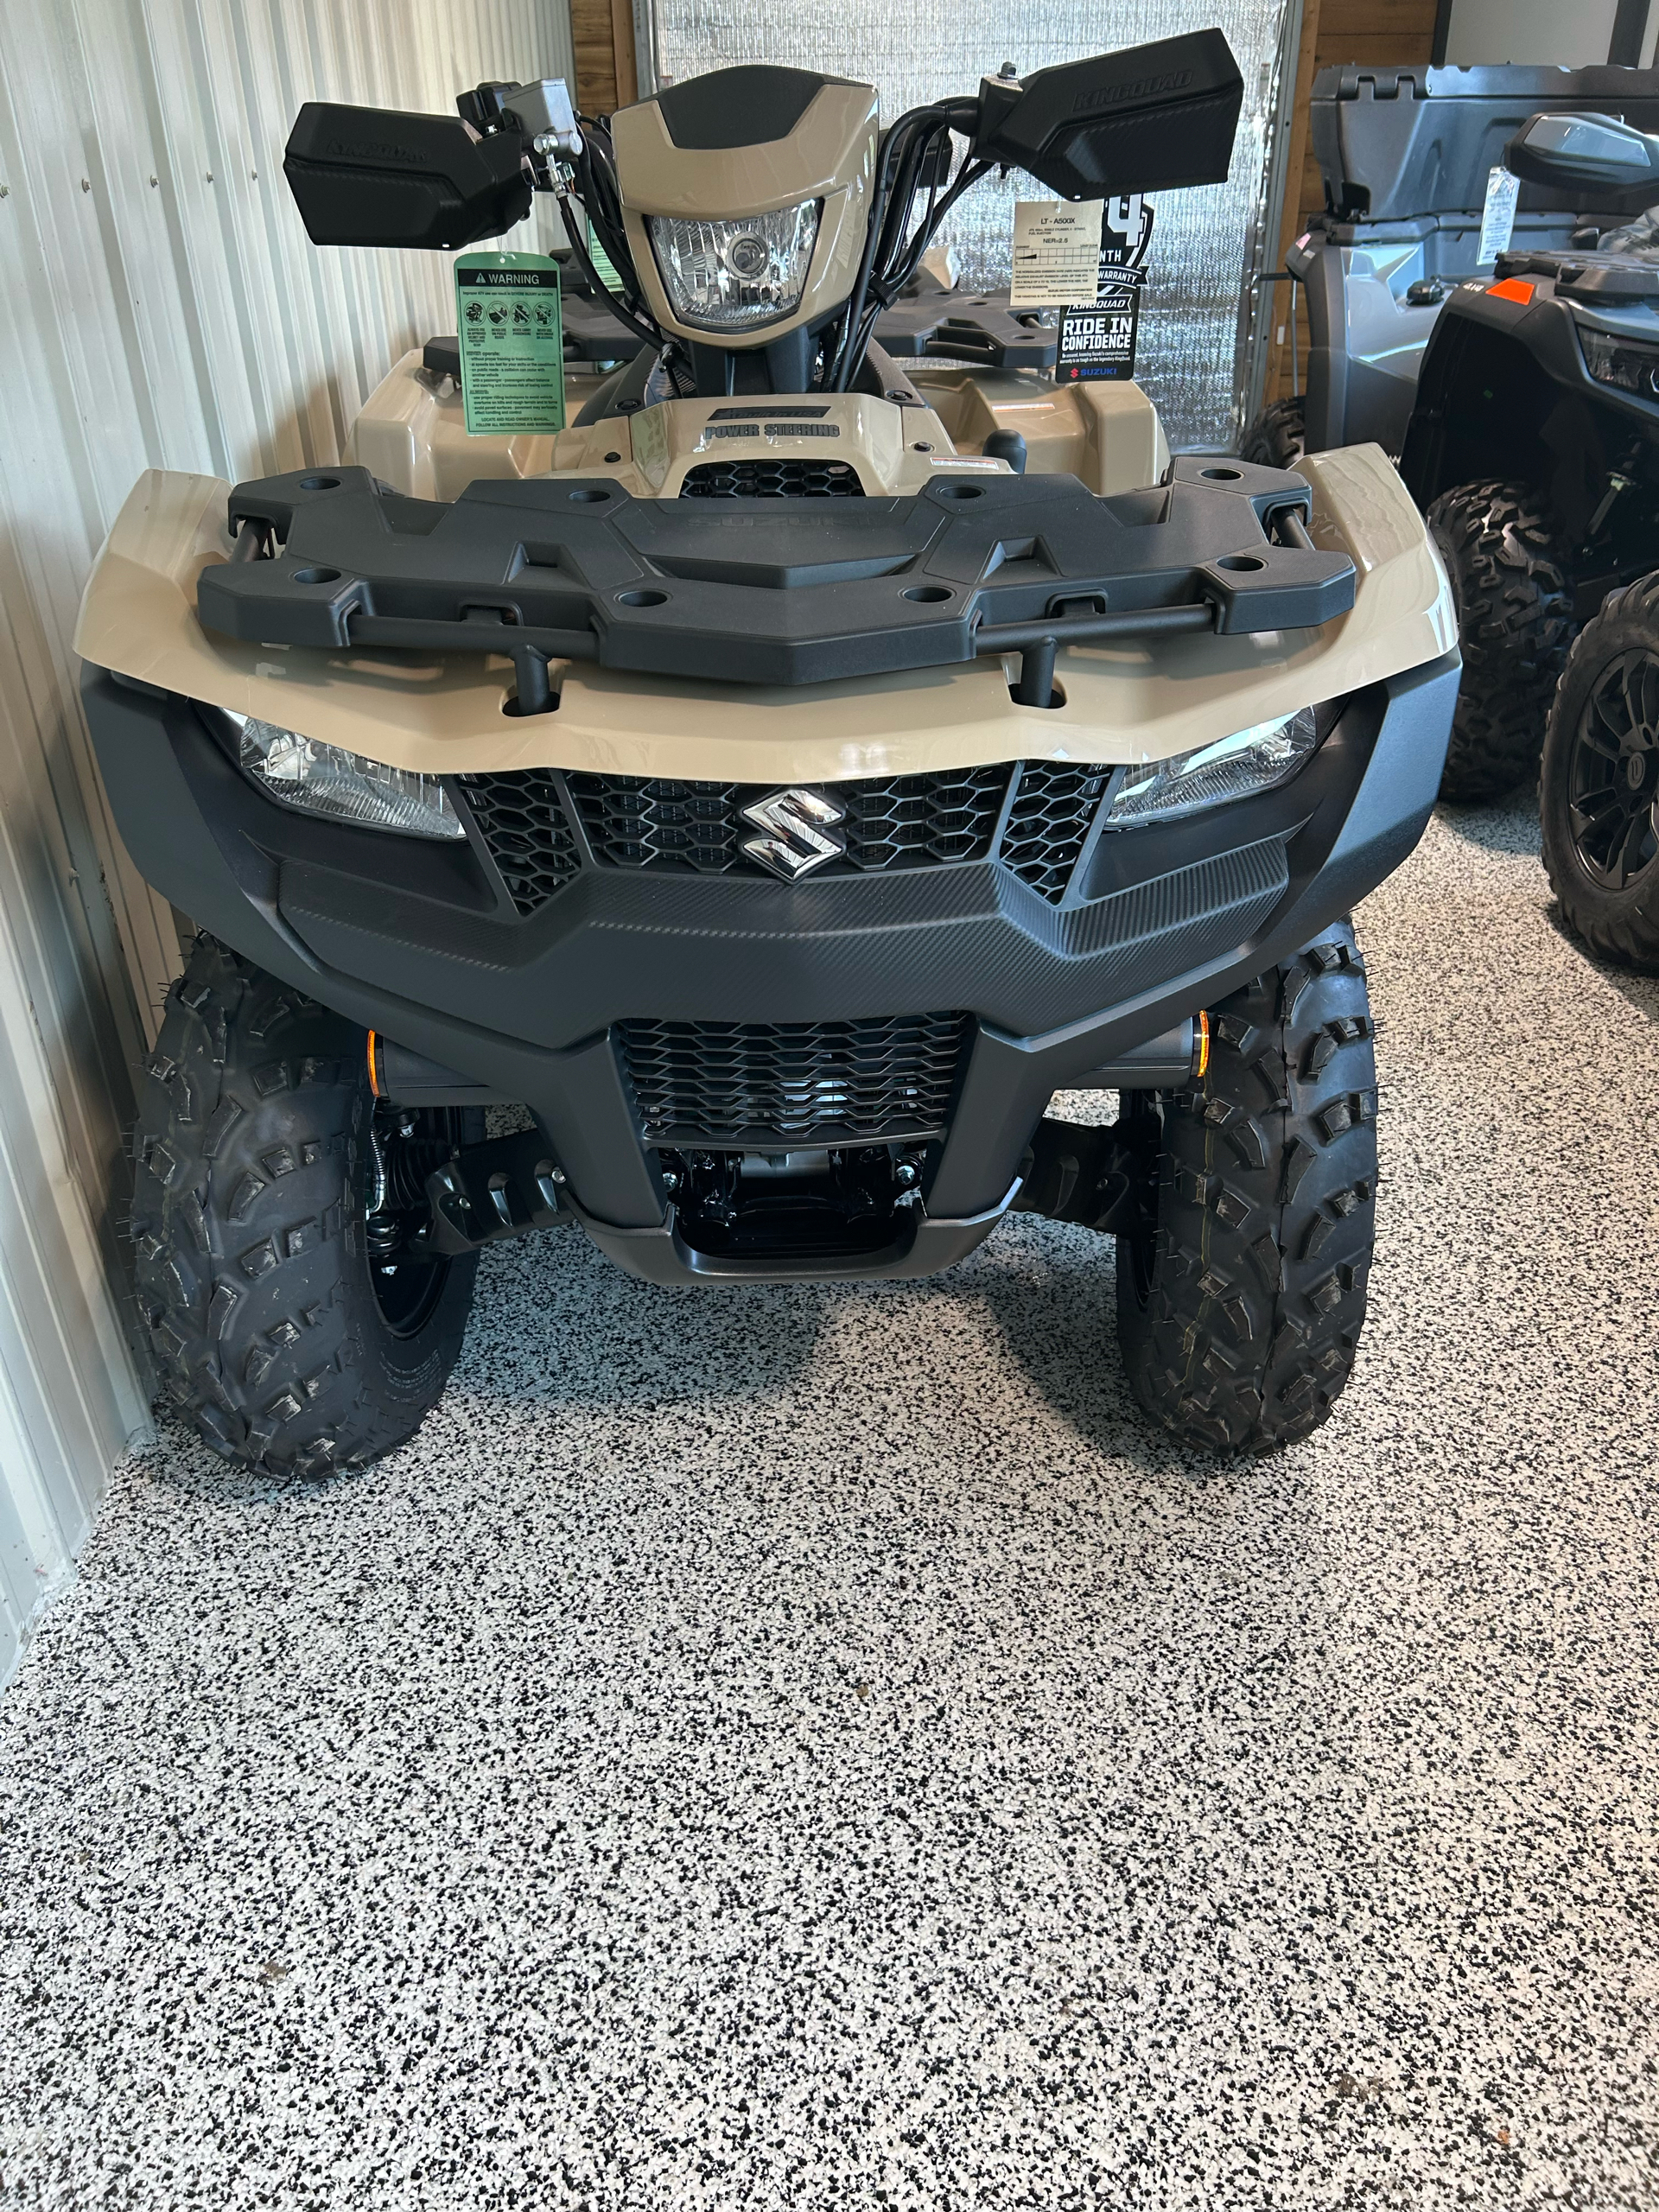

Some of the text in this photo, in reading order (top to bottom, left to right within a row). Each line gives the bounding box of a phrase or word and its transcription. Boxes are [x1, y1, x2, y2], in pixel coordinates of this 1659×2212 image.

[1072, 69, 1193, 111] KINGQUAD
[1099, 250, 1122, 263] NTH
[488, 274, 540, 285] WARNING
[1098, 270, 1137, 283] WARRANTY
[1063, 317, 1133, 337] RIDE IN
[1062, 334, 1131, 352] CONFIDENCE
[1081, 368, 1117, 377] SUZUKI
[705, 423, 841, 439] POWER STEERING
